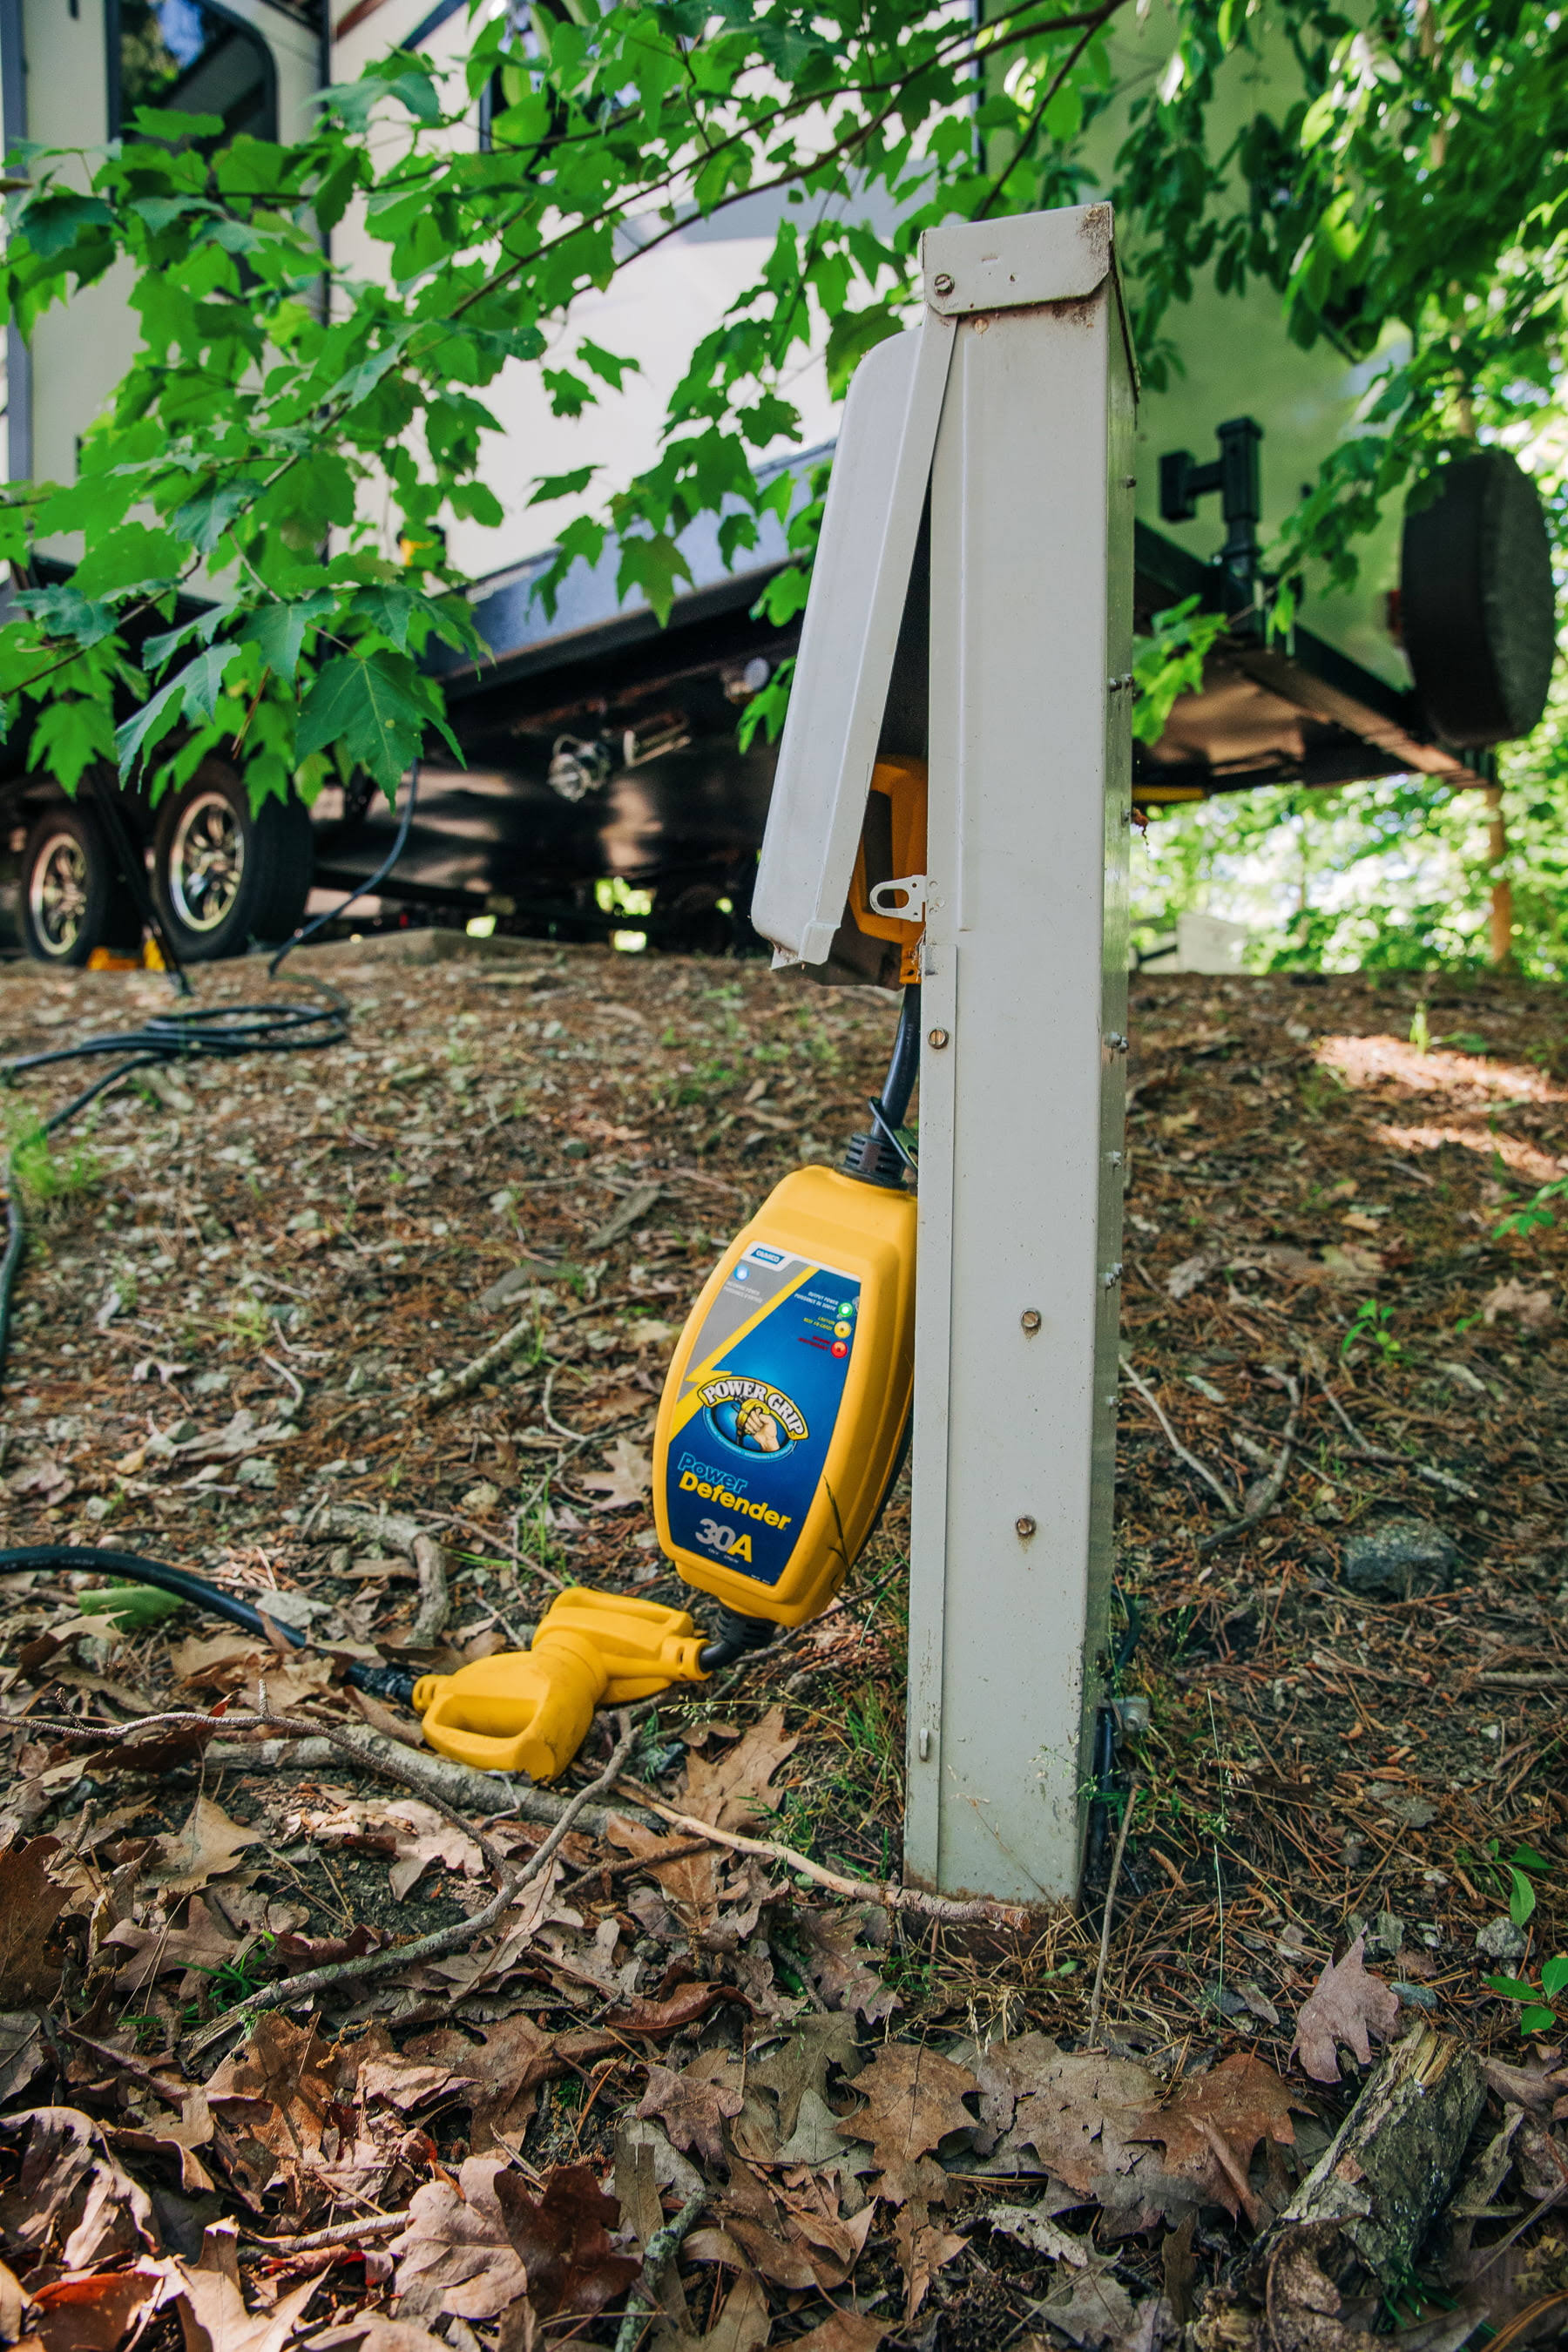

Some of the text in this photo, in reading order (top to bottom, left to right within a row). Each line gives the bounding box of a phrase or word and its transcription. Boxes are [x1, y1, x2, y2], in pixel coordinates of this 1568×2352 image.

[702, 1379, 768, 1405] POWER
[767, 1393, 804, 1435] GRIP
[678, 1451, 749, 1494] Power
[679, 1470, 792, 1531] Defender
[694, 1517, 753, 1563] 30A
